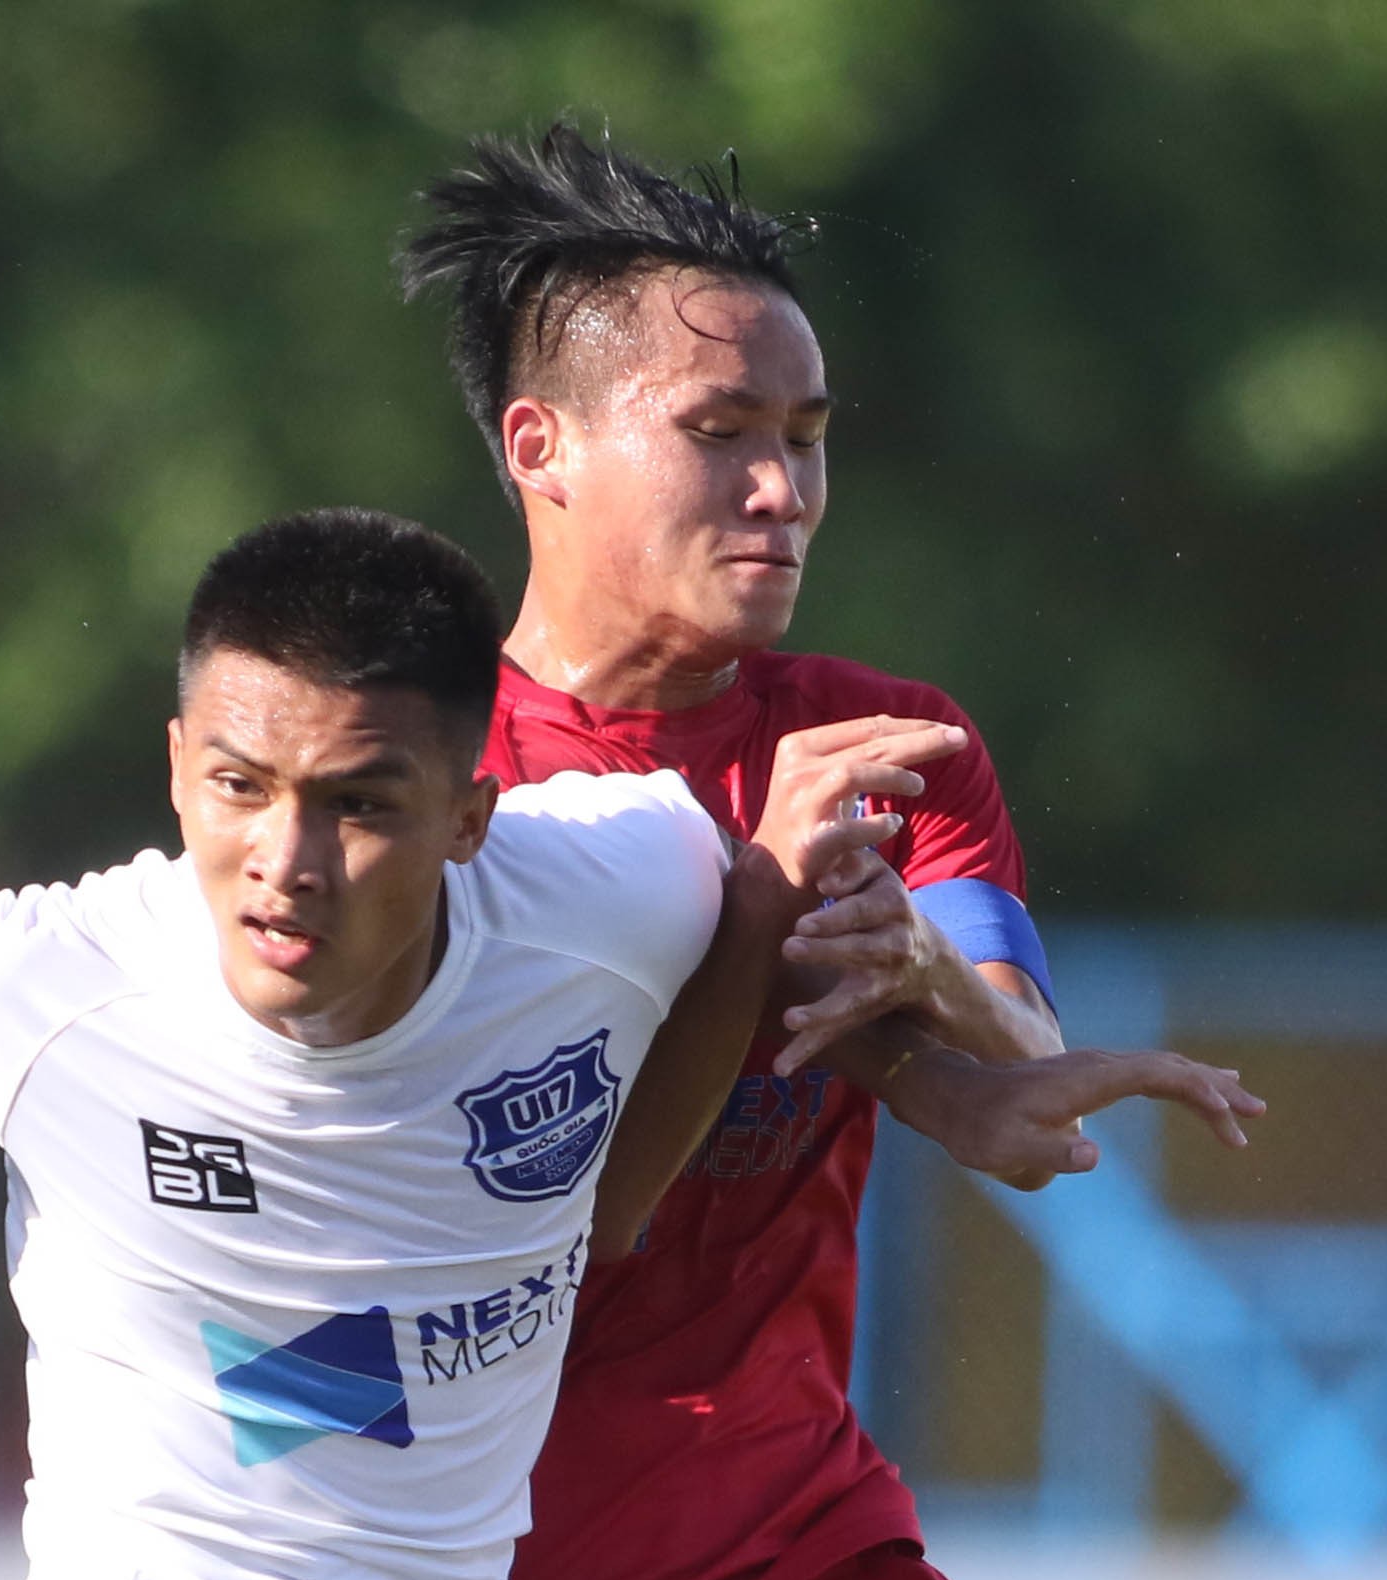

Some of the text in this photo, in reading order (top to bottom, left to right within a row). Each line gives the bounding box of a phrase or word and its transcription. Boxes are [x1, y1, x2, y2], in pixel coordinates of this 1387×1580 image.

[505, 1074, 573, 1133] U17
[722, 1067, 834, 1130] EXT
[416, 1231, 584, 1347] NEXT
